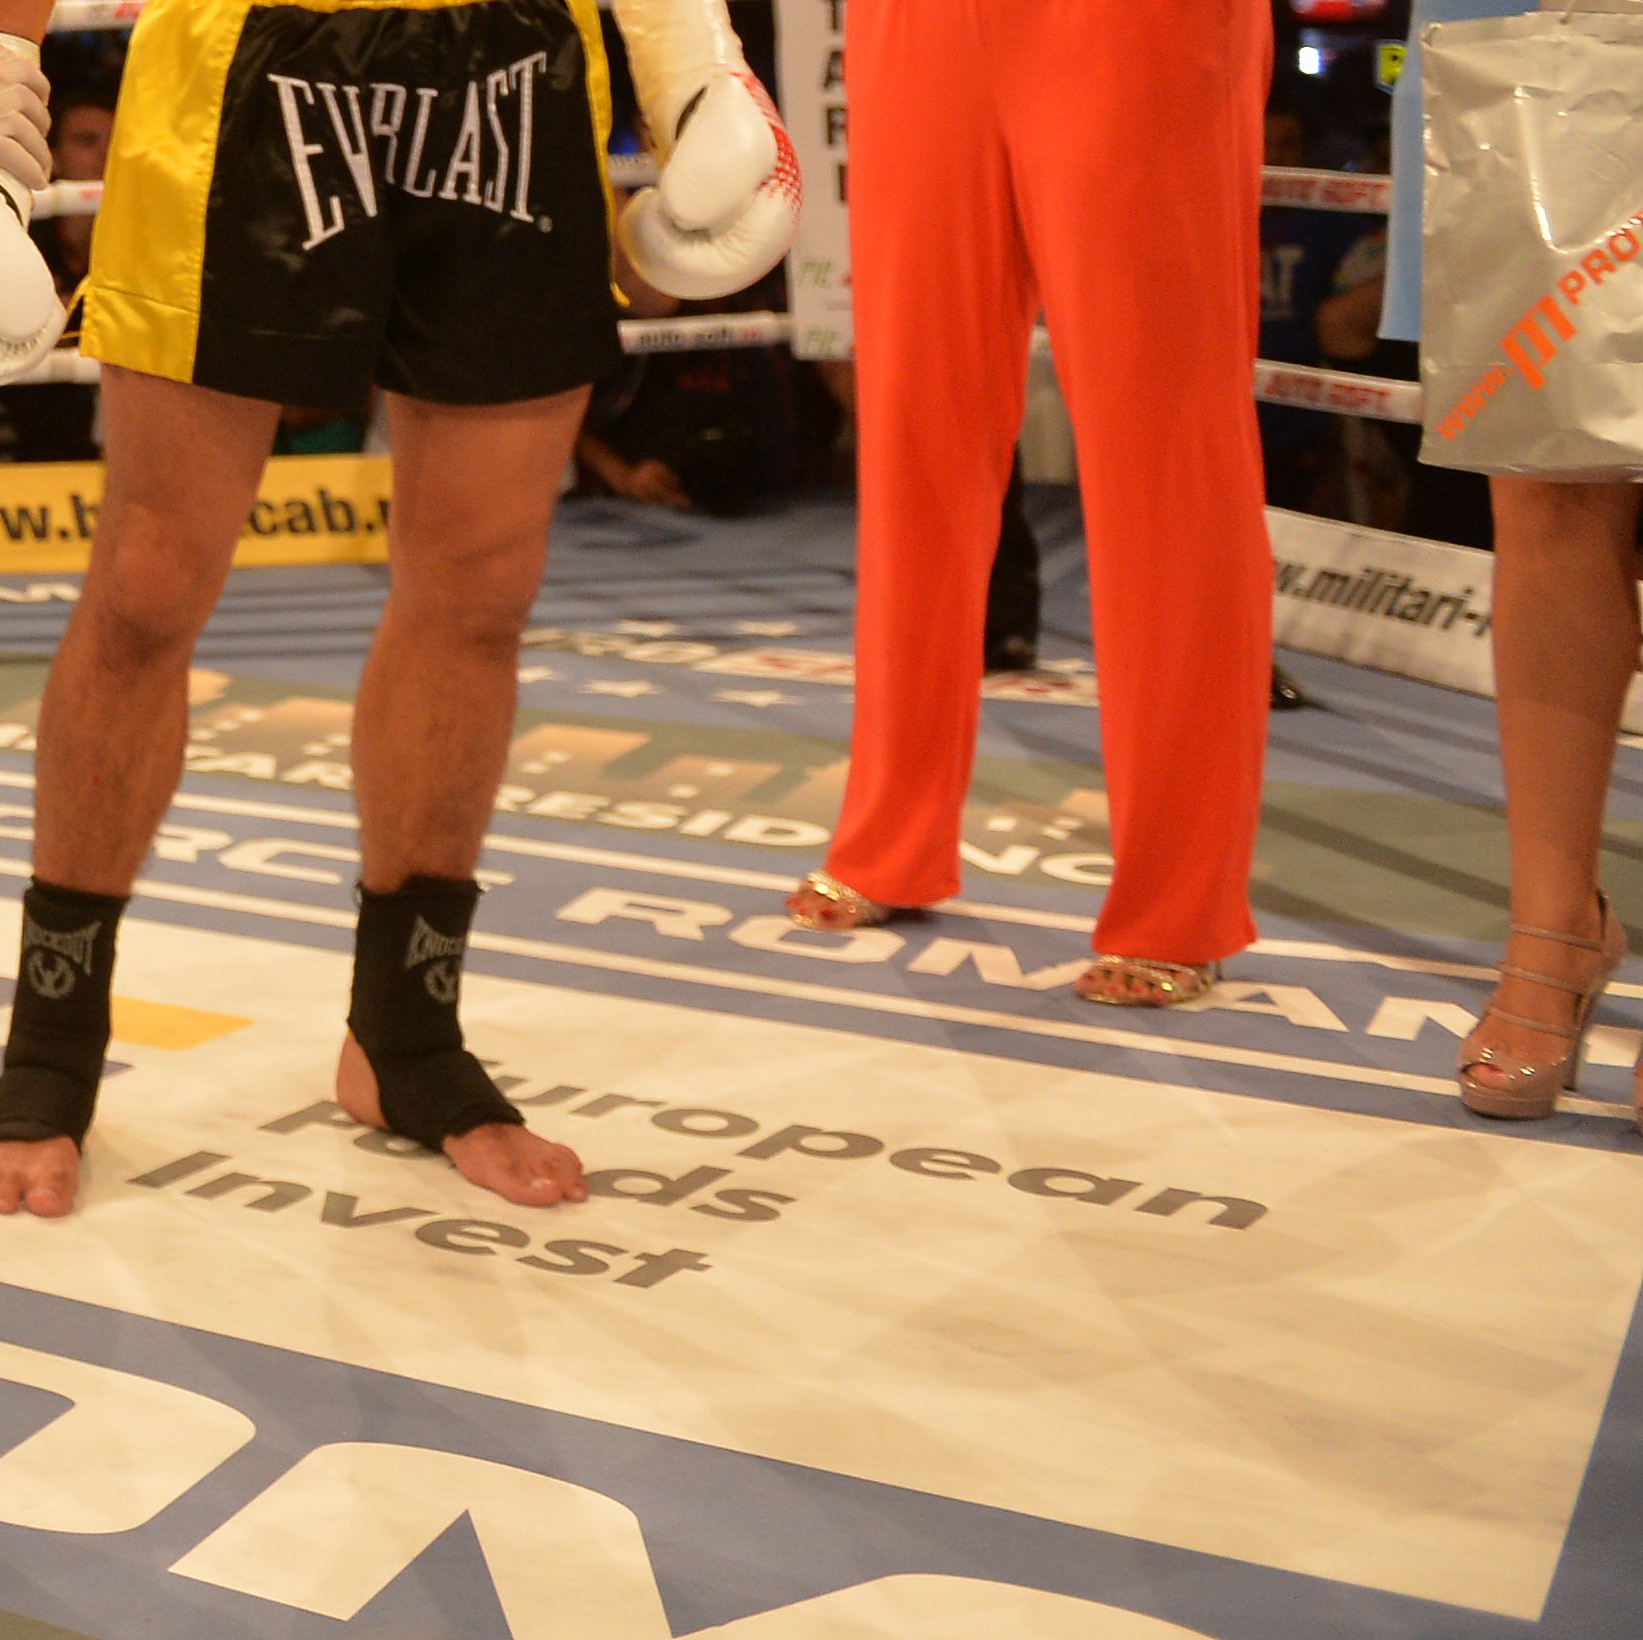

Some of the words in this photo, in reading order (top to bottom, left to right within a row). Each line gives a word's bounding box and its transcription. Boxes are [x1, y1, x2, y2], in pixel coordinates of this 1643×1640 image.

[1556, 206, 1643, 306] PRO
[480, 1058, 1270, 1231] uropean
[126, 1149, 714, 1290] Invest
